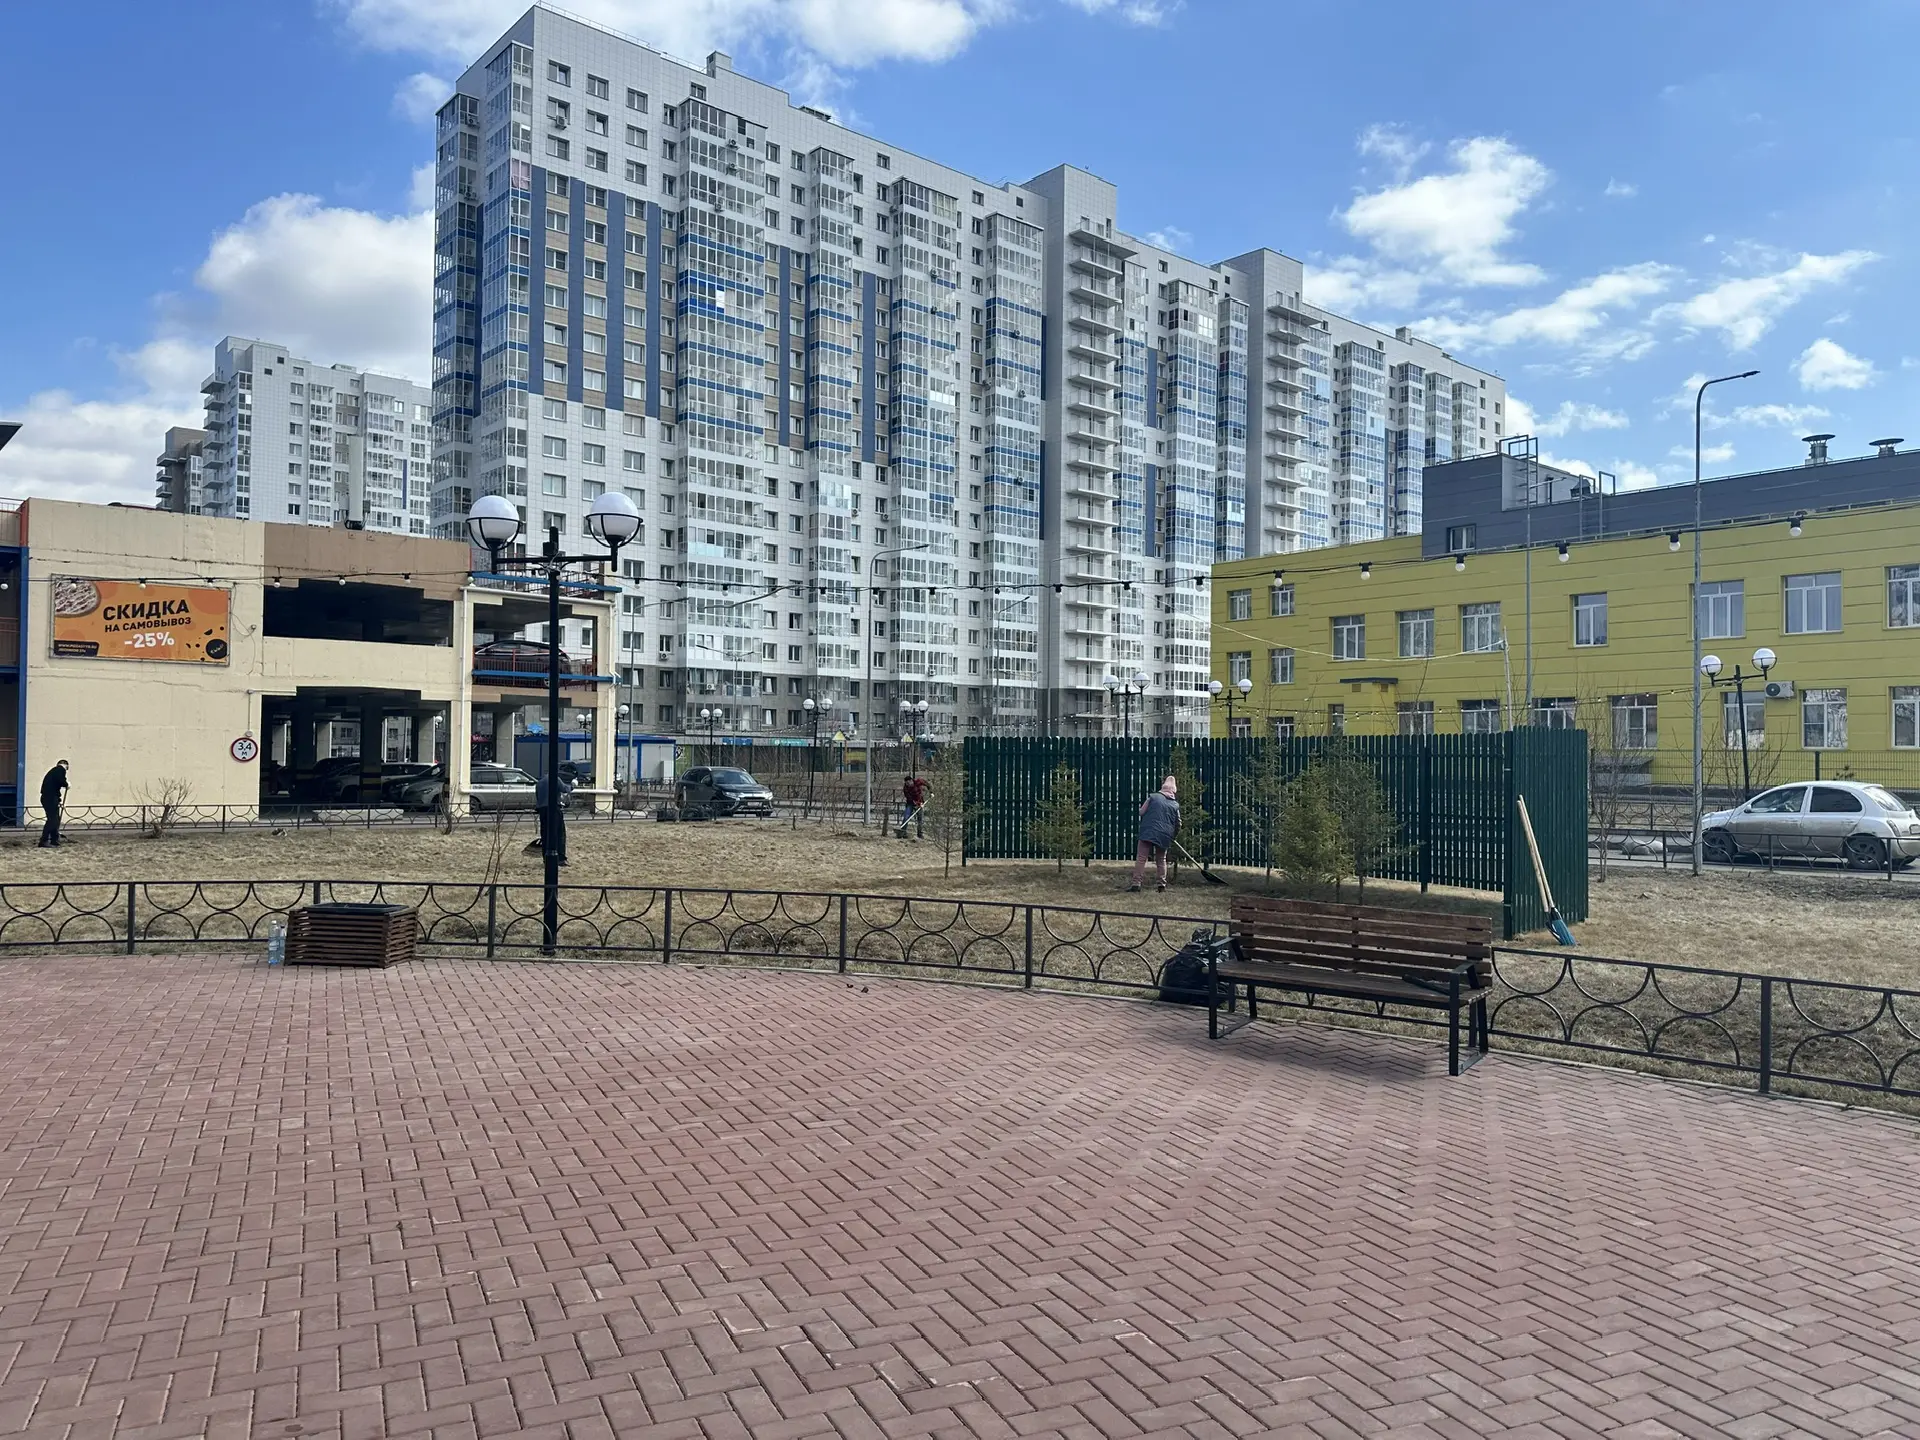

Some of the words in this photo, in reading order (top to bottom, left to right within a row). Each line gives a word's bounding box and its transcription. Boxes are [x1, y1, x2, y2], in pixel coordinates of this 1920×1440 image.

[103, 599, 189, 621] СКИДКА
[104, 623, 120, 633] НА
[122, 616, 192, 631] САМОВЫВОЗ
[124, 631, 175, 649] -25%
